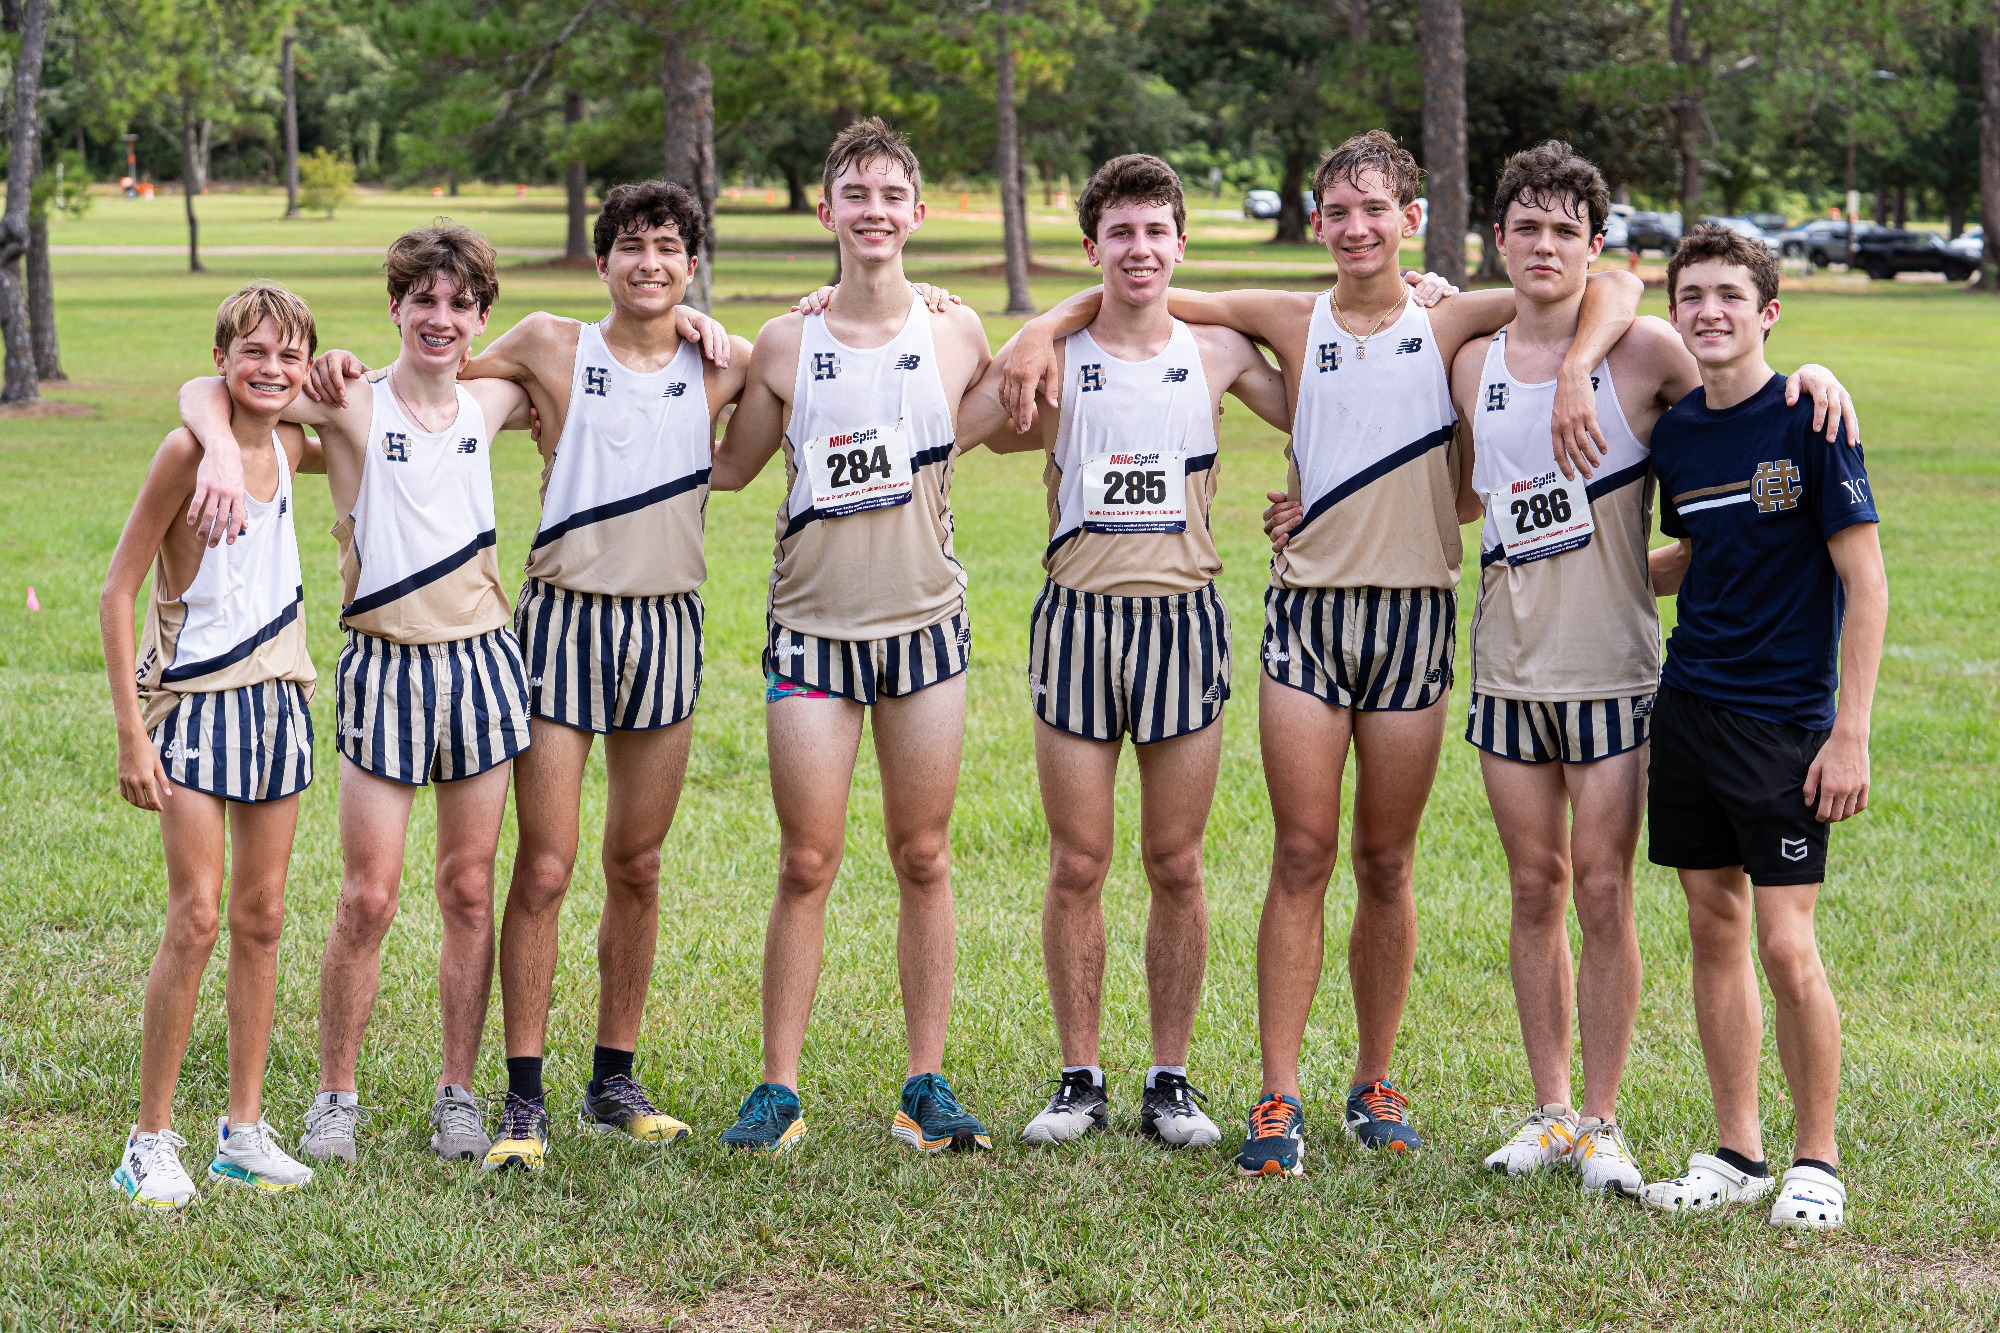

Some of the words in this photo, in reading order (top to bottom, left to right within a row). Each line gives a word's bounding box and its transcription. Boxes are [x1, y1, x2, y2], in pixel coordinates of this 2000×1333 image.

[829, 428, 877, 448] MileSplit
[827, 445, 891, 488] 284
[1110, 453, 1159, 466] MileSplit
[1104, 471, 1166, 504] 285
[1511, 472, 1556, 494] MileSplit
[1841, 478, 1867, 504] XC
[1511, 488, 1572, 534] 286
[775, 637, 804, 661] Tigers
